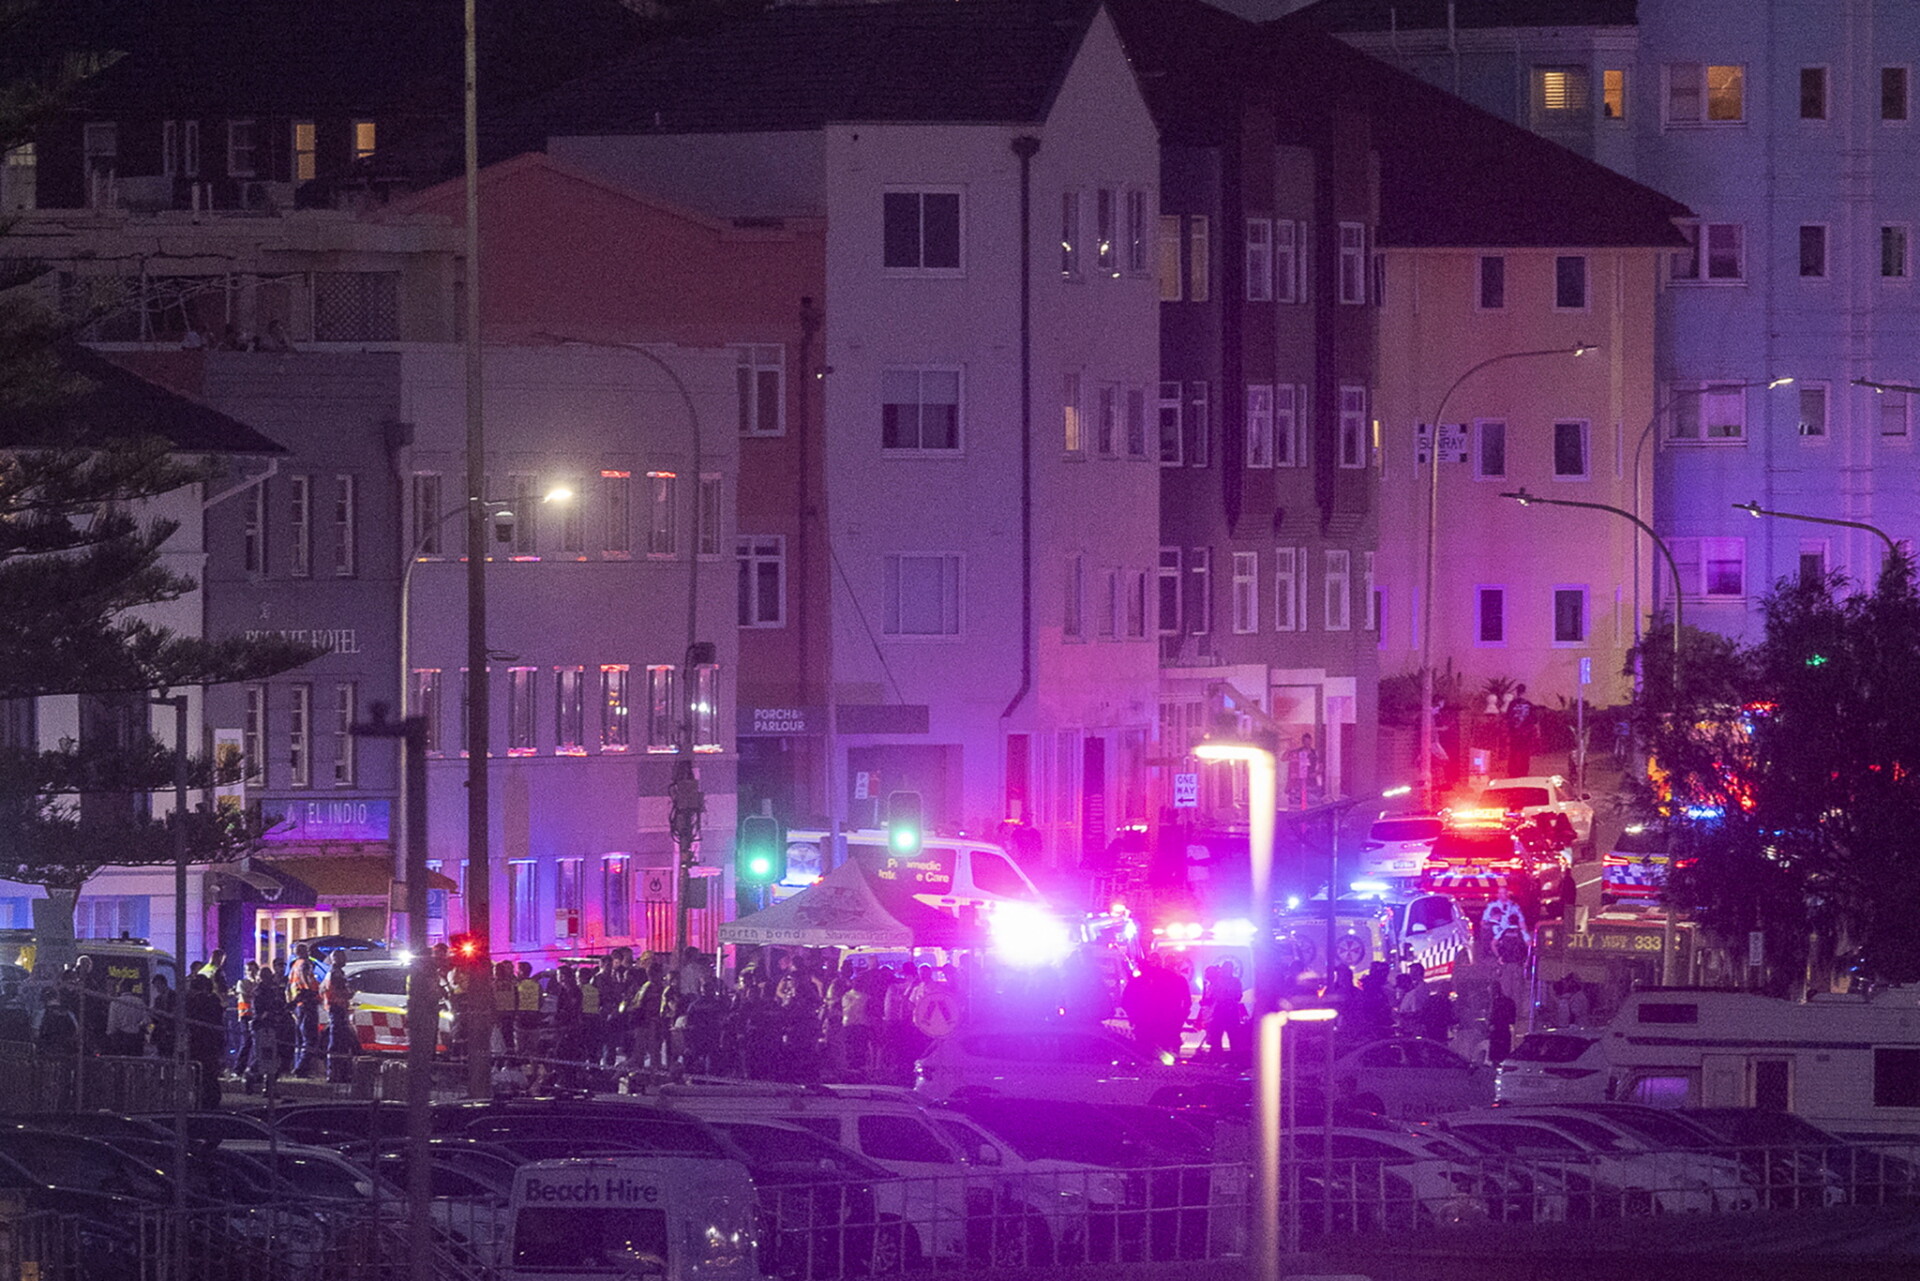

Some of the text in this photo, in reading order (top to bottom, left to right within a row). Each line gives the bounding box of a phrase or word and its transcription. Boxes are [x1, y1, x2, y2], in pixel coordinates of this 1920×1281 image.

[311, 629, 360, 653] HOTEL
[754, 721, 805, 732] PARLOUR
[1177, 775, 1195, 785] ONE
[1177, 786, 1196, 795] WAY
[308, 803, 368, 824] EL INDIO
[887, 858, 942, 871] Pamedic
[925, 871, 950, 883] Care
[719, 928, 759, 940] north
[1634, 935, 1662, 950] 333
[525, 1178, 658, 1203] Beach Hire
